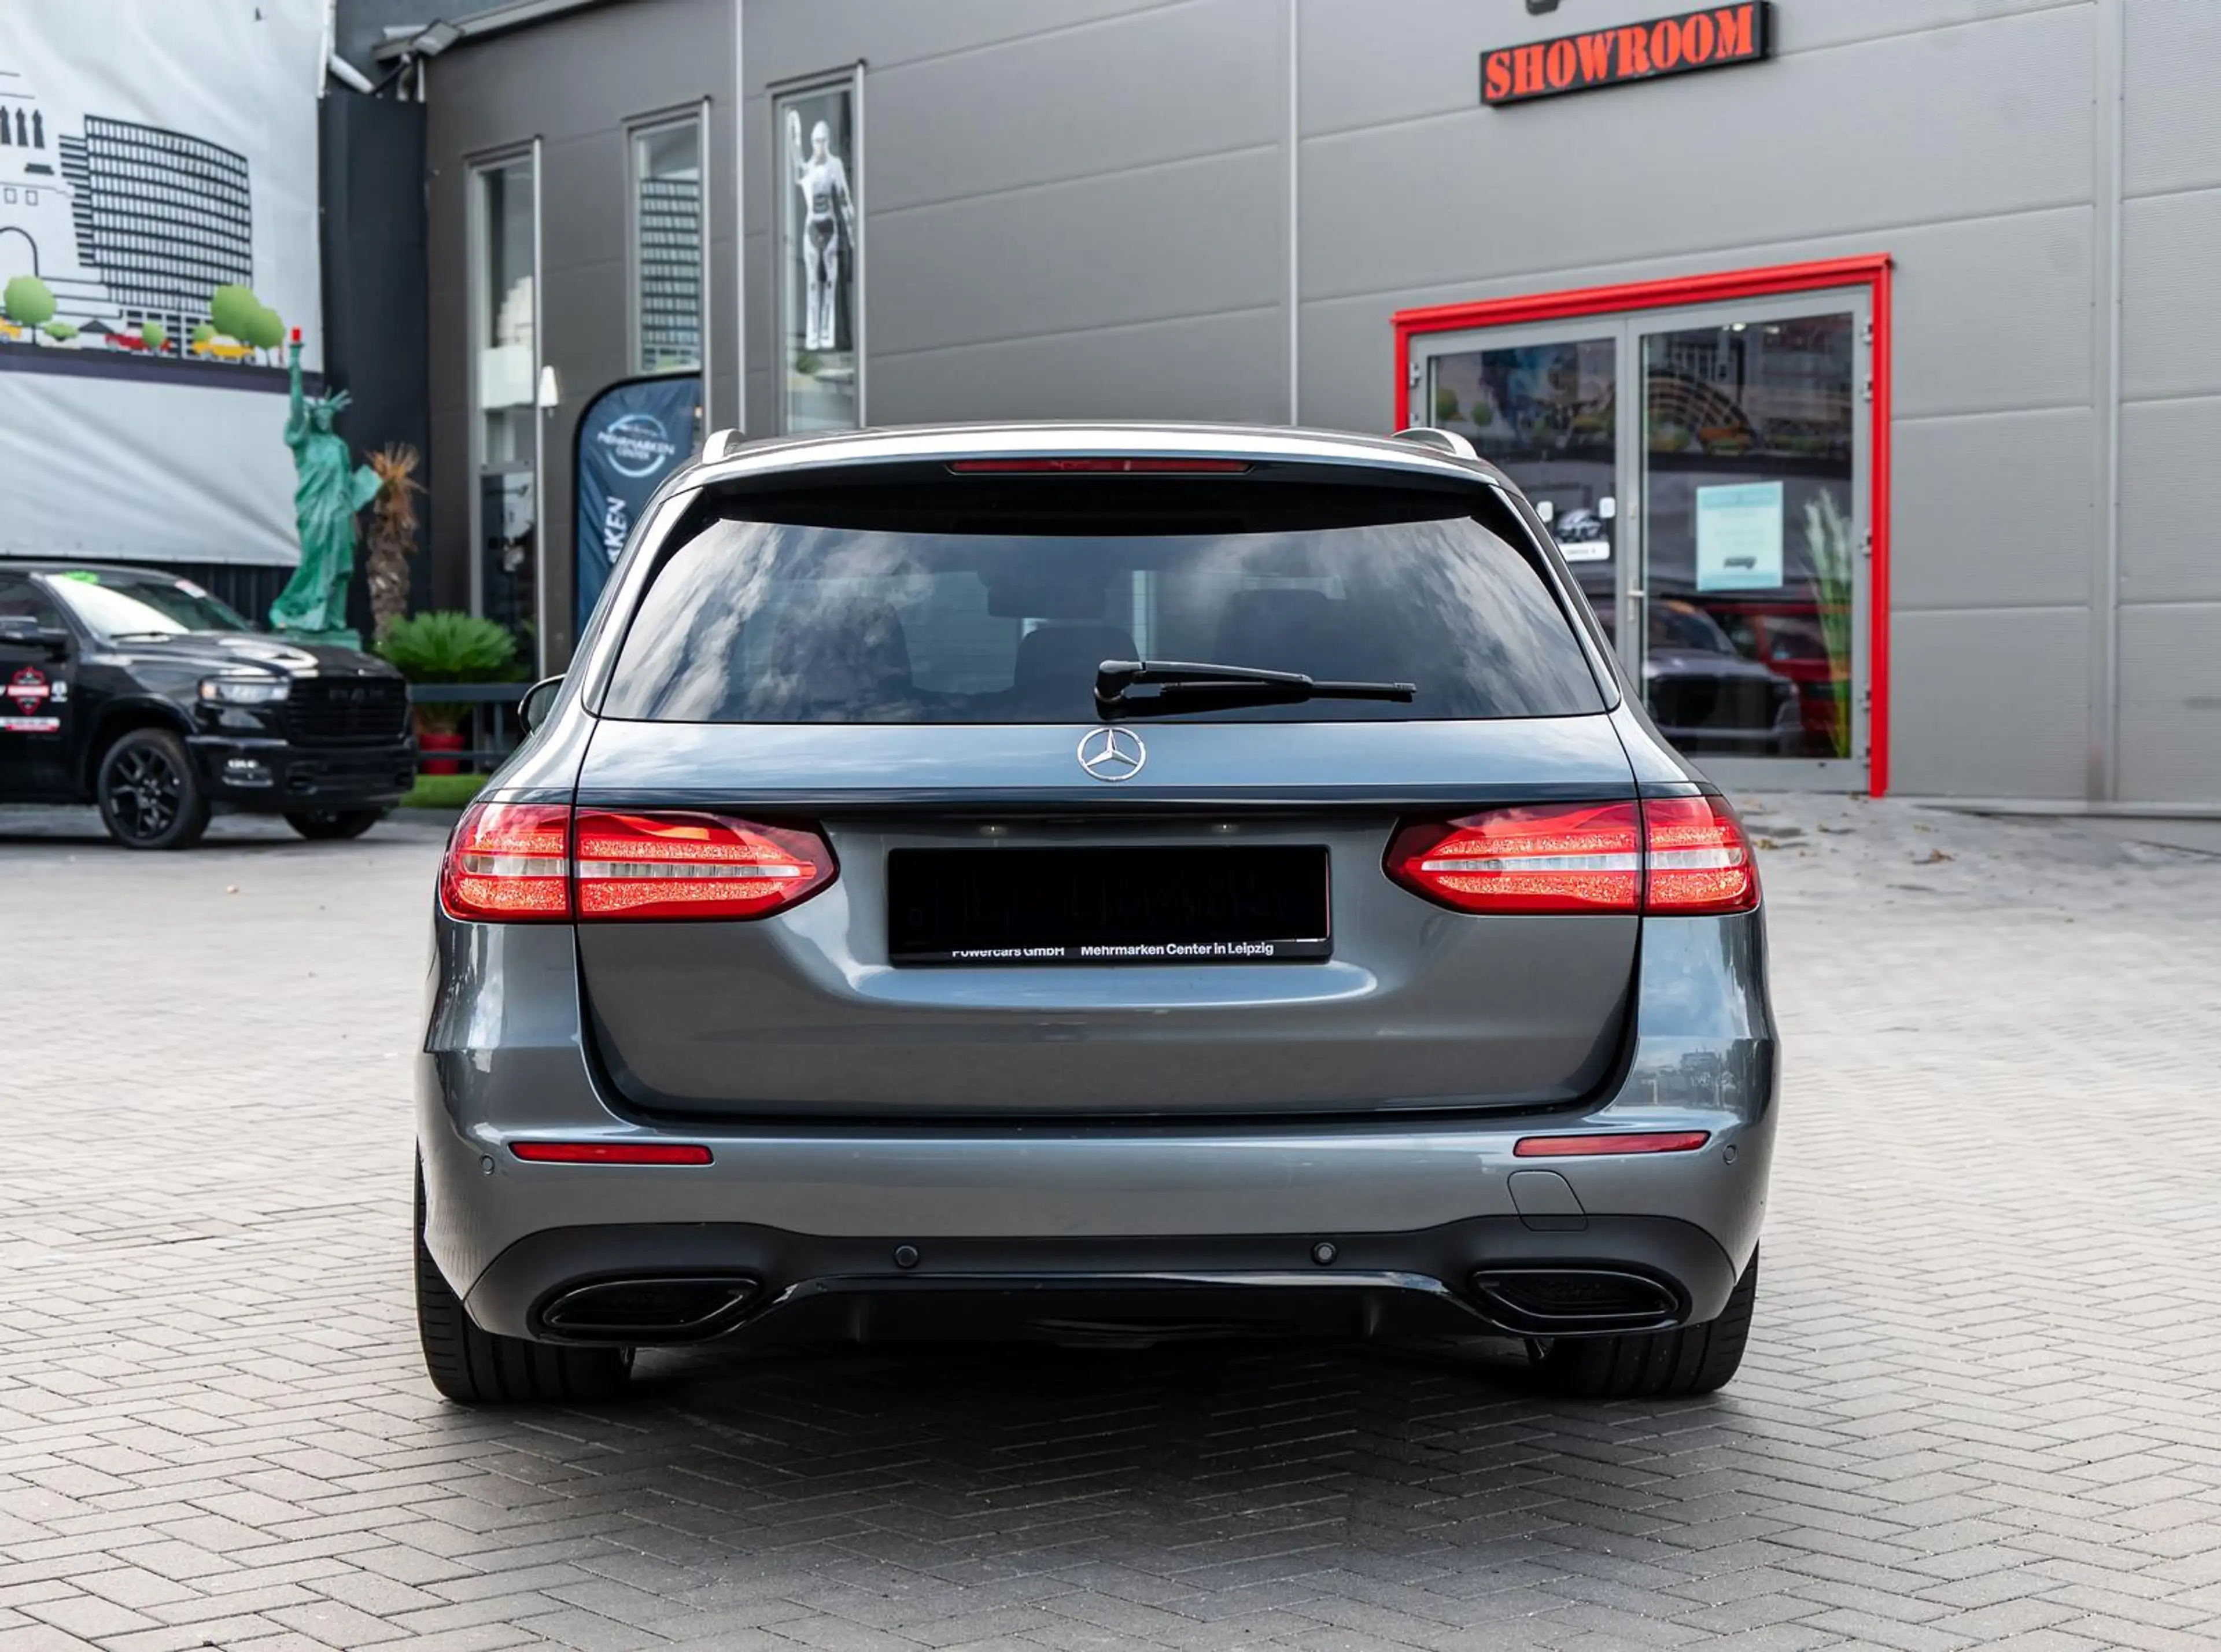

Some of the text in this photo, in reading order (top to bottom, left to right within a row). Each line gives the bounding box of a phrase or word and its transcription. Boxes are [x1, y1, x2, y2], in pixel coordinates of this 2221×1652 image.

[1485, 5, 1753, 99] SHOWROOM
[1080, 944, 1164, 956] Mehrmarken
[1166, 943, 1212, 955] Center
[1214, 942, 1226, 954] in
[1228, 942, 1274, 956] Leipzig
